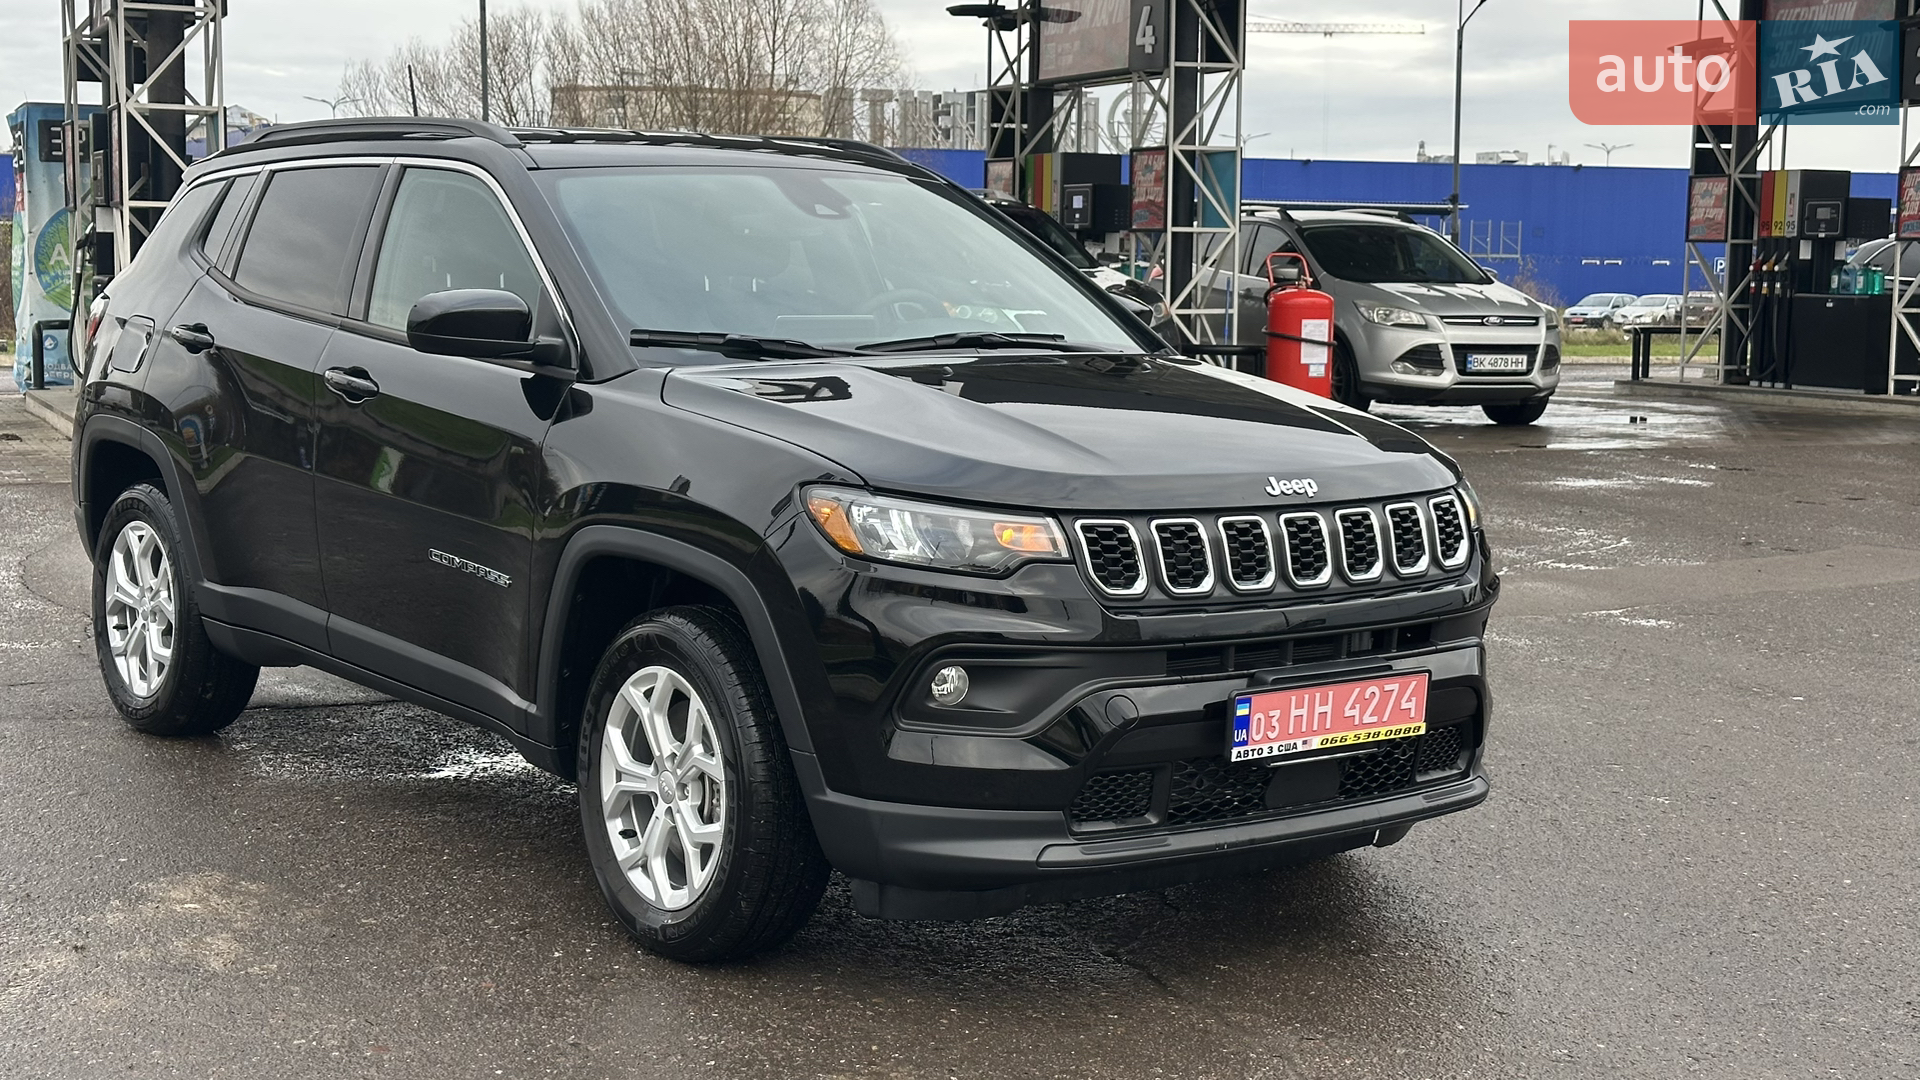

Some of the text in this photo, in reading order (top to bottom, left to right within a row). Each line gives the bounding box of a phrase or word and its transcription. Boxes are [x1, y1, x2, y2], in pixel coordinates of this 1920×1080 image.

[1136, 5, 1156, 54] 4
[1773, 220, 1783, 231] 92
[1786, 220, 1796, 231] 95
[1472, 357, 1524, 368] BK 4878 HH
[1265, 476, 1318, 498] Jeep
[428, 548, 512, 588] COMPASS
[1251, 680, 1419, 742] 03 HH 4274
[1234, 728, 1248, 743] UA
[1235, 748, 1264, 760] АВТО
[1277, 741, 1298, 753] США
[1319, 725, 1422, 747] 066-538-0888
